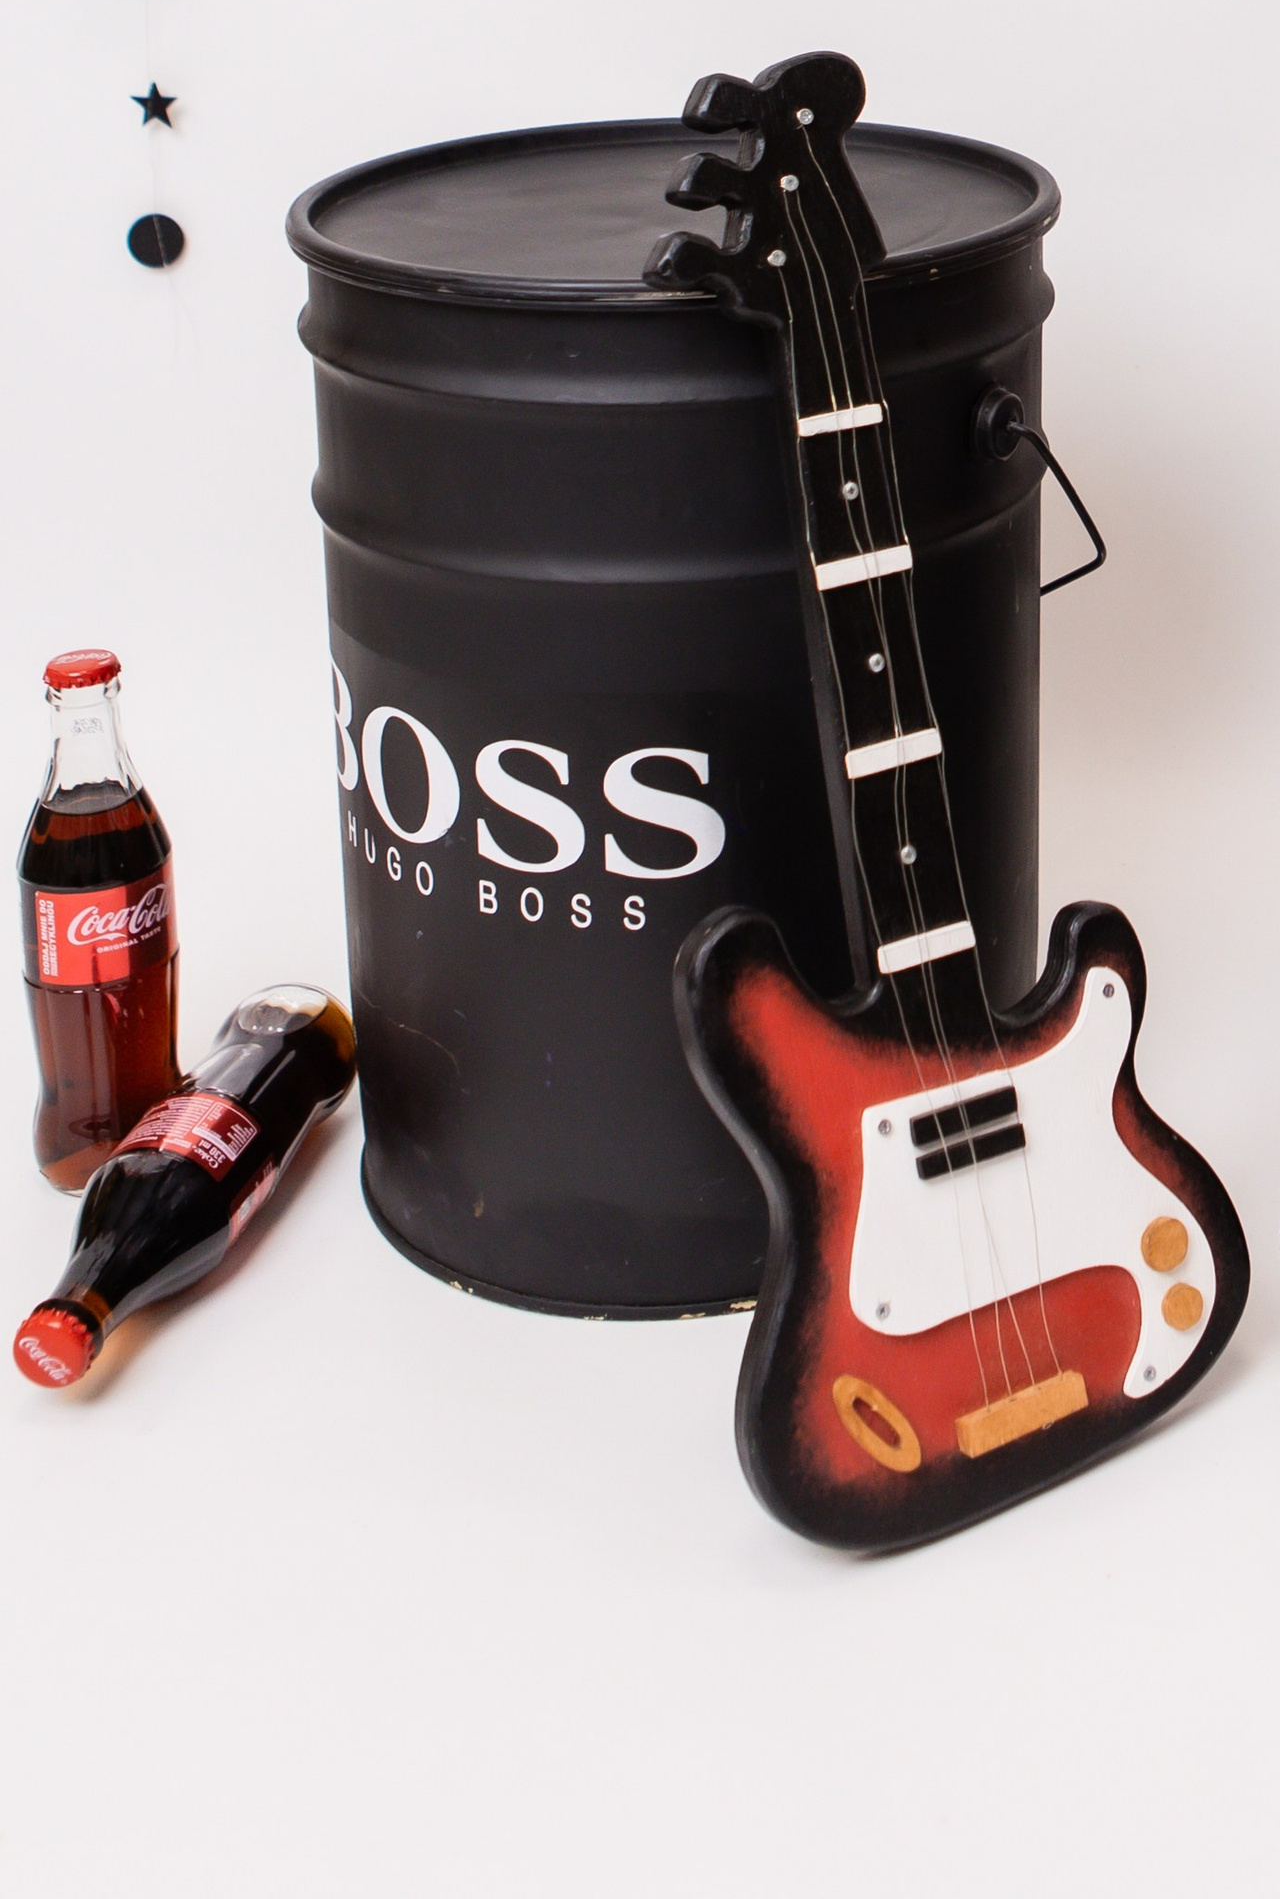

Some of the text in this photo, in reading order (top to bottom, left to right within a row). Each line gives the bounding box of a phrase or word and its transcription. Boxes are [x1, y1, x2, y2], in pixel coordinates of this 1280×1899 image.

[347, 809, 647, 931] HUGO BOSS
[67, 883, 170, 946] Coca-Cola
[96, 937, 139, 954] ORIGINAL
[198, 1138, 226, 1163] 330 ml
